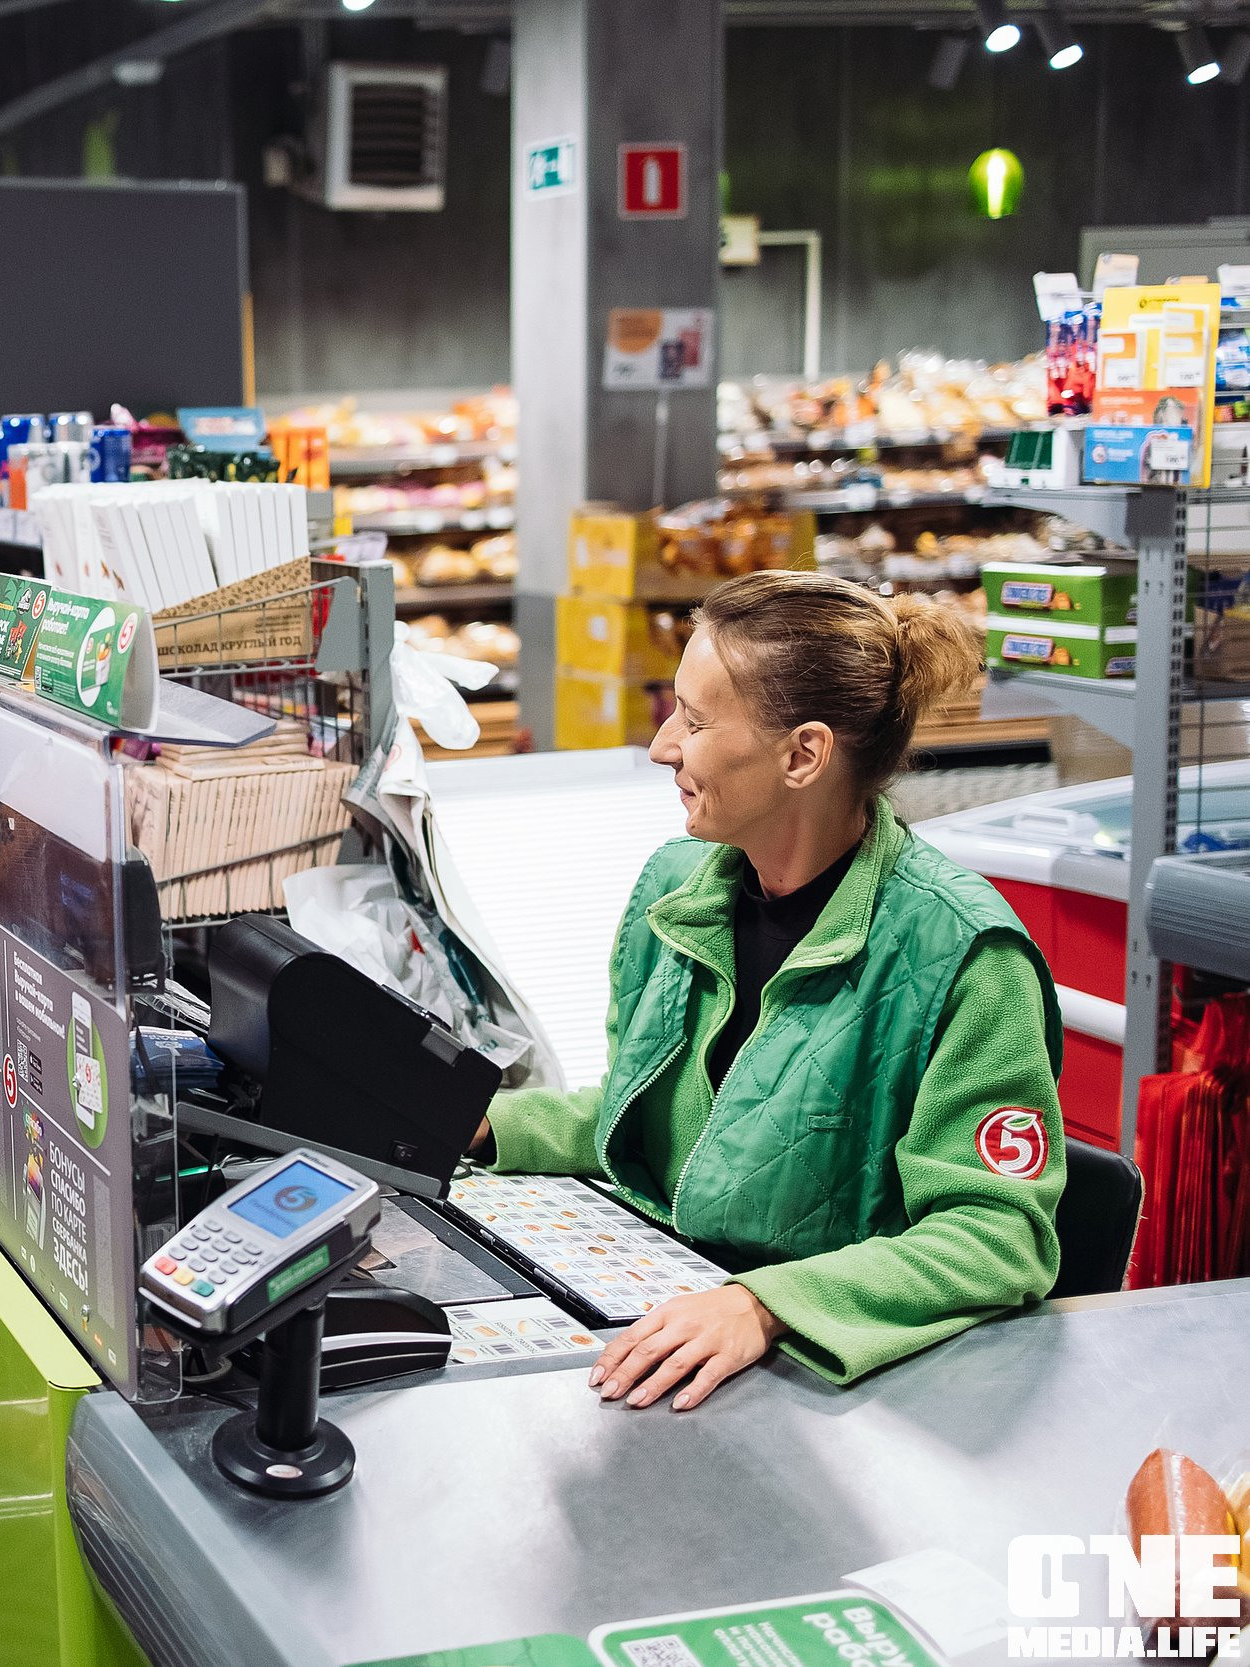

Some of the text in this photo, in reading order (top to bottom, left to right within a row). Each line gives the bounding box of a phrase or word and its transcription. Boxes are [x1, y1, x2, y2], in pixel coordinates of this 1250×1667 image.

[158, 635, 302, 656] ШОКОЛАД КРУГЛЫЙ ГОД
[49, 1140, 86, 1194] БОНУСЫ
[50, 1168, 86, 1218] СПАСИБО
[51, 1191, 87, 1244] ПО КАРТЕ
[52, 1216, 88, 1266] СБЕРБАНКА
[53, 1236, 89, 1297] ЗДЕСЬ!
